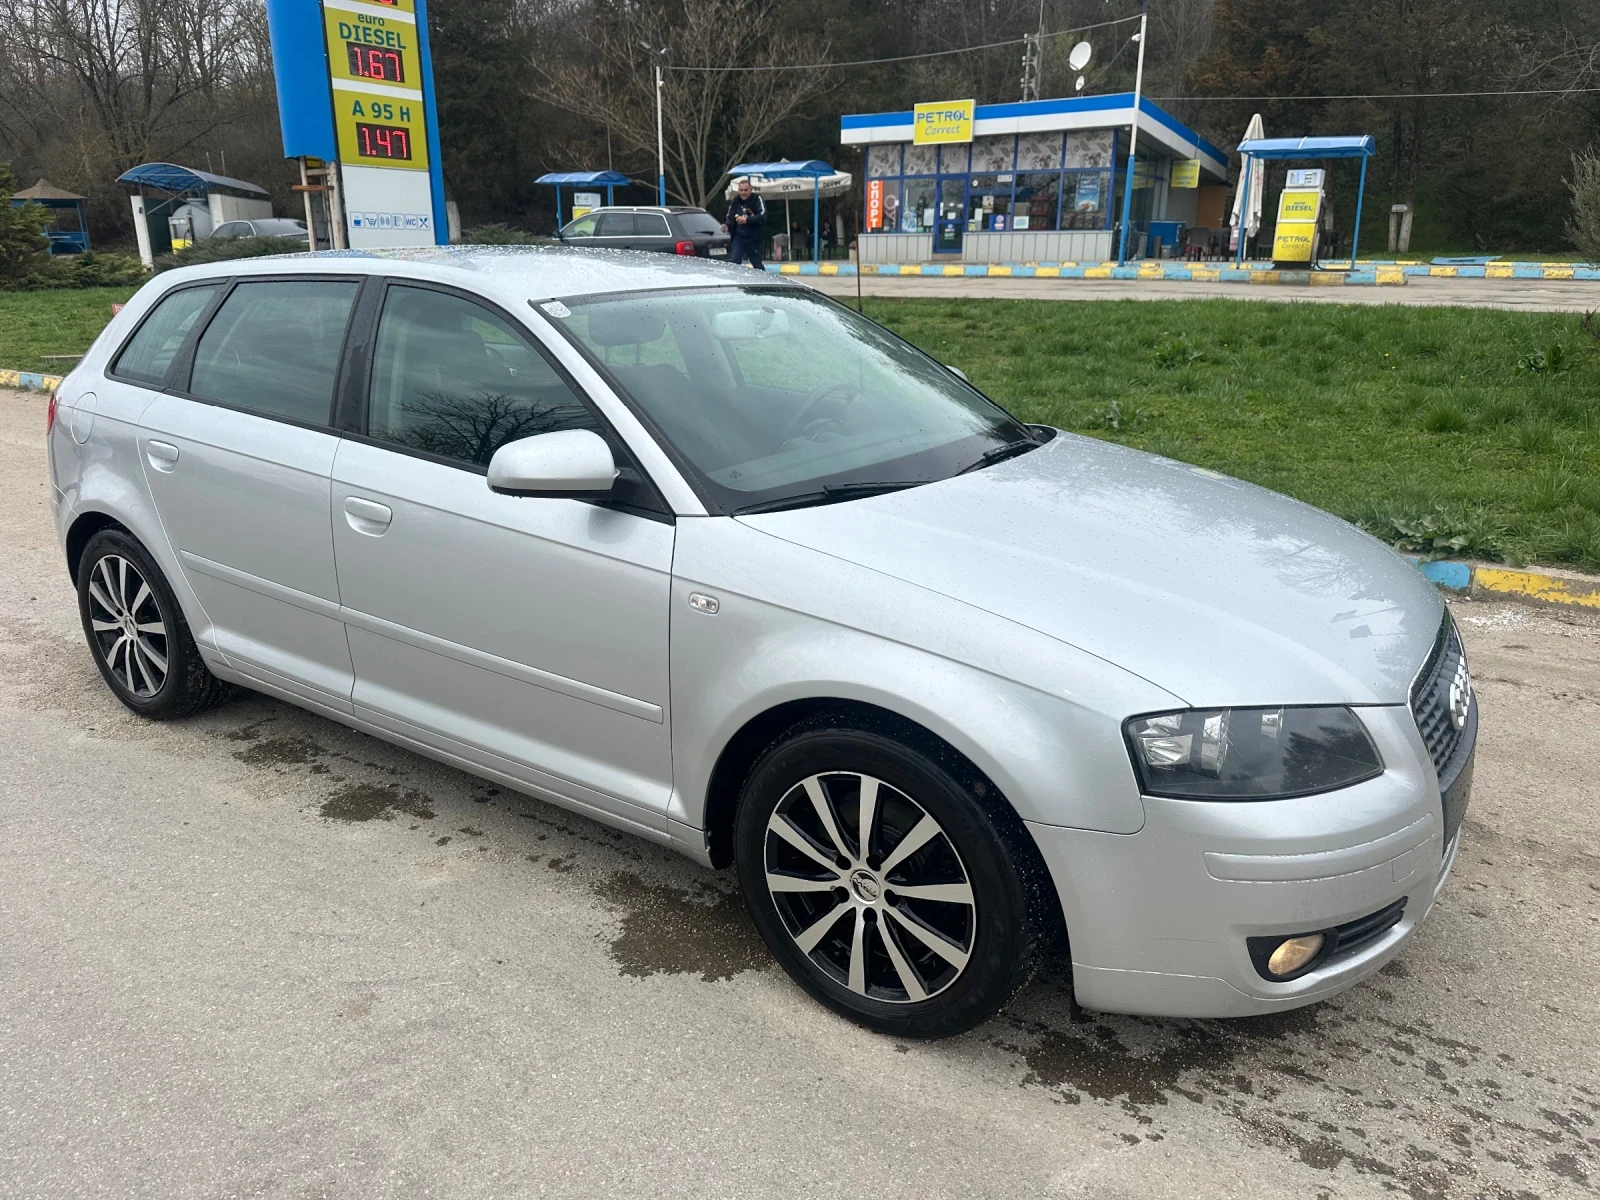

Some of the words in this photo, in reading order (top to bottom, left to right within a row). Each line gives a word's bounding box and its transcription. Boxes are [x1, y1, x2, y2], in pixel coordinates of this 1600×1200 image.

[357, 13, 385, 27] euro
[338, 21, 407, 50] DIESEL
[353, 46, 401, 82] 1.67
[352, 99, 365, 117] A
[371, 101, 394, 120] 95
[399, 105, 411, 123] H
[917, 110, 970, 124] PETROL
[924, 125, 961, 136] Correct
[361, 126, 407, 158] 1.47
[870, 180, 879, 228] СПОРТ
[405, 218, 417, 226] WC
[1277, 235, 1311, 243] PETROL
